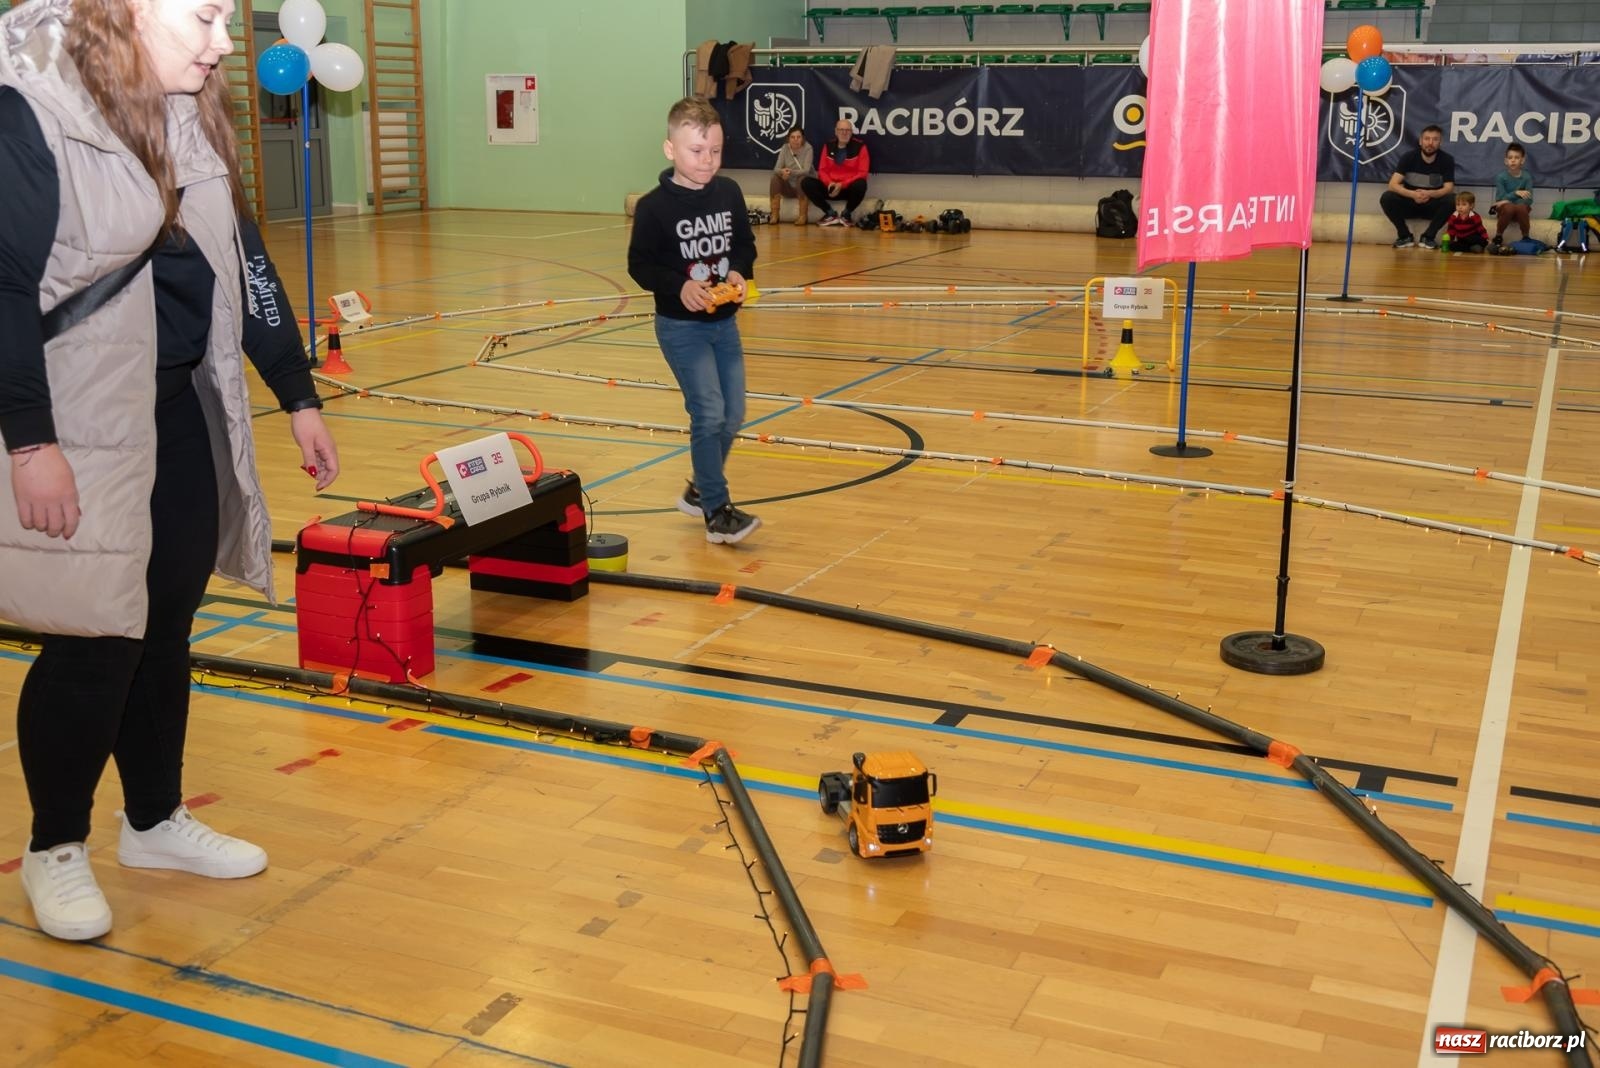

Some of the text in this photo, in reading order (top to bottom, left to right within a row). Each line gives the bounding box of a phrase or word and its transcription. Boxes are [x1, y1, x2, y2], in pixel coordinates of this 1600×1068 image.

[839, 97, 1024, 136] RACIBÓRZ
[676, 211, 732, 239] GAME
[680, 232, 732, 259] MODE
[471, 483, 512, 504] Grupa Rybnik
